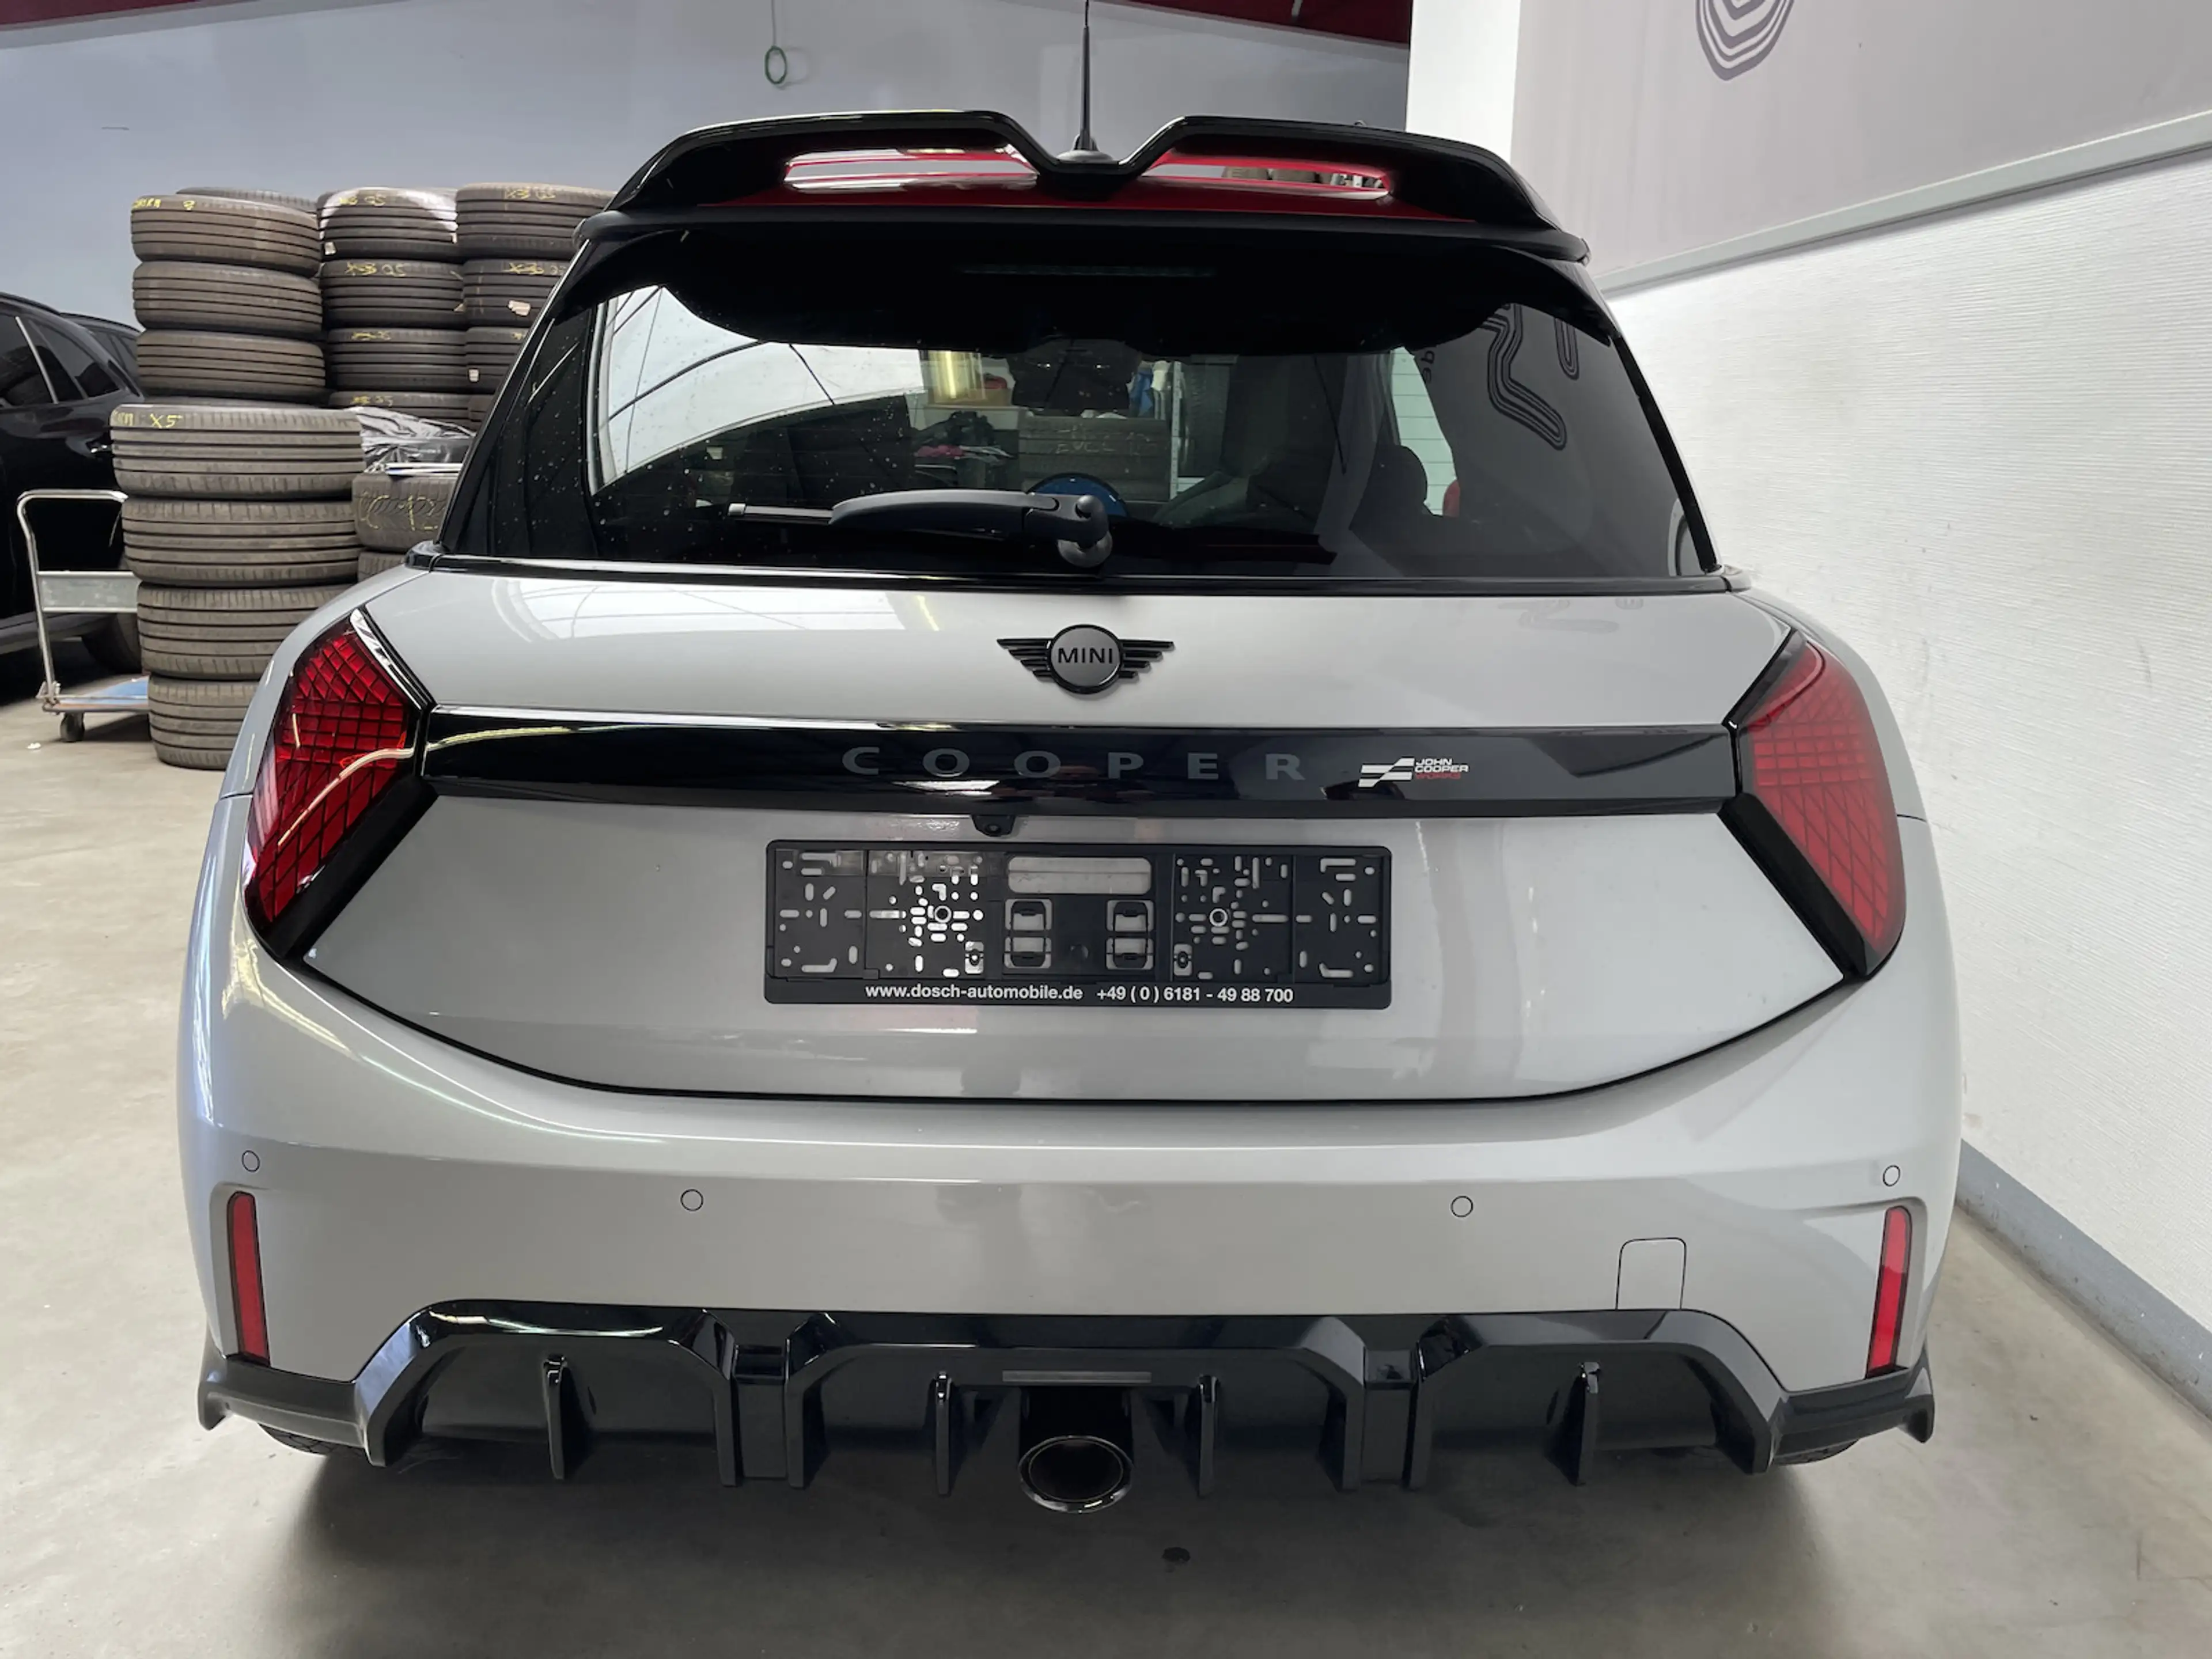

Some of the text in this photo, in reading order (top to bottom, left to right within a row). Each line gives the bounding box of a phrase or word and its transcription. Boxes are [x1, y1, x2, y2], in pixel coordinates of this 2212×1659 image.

[149, 413, 183, 429] X5
[1057, 647, 1113, 664] MINI
[842, 746, 1305, 781] COOPER
[1415, 757, 1453, 766] JOHN
[865, 983, 1084, 999] www.dosch-automobile.de
[1096, 986, 1126, 999] +49
[1163, 987, 1200, 1001] 6181
[1217, 987, 1237, 1002] 49
[1240, 988, 1261, 1002] 88
[1265, 988, 1294, 1003] 700
